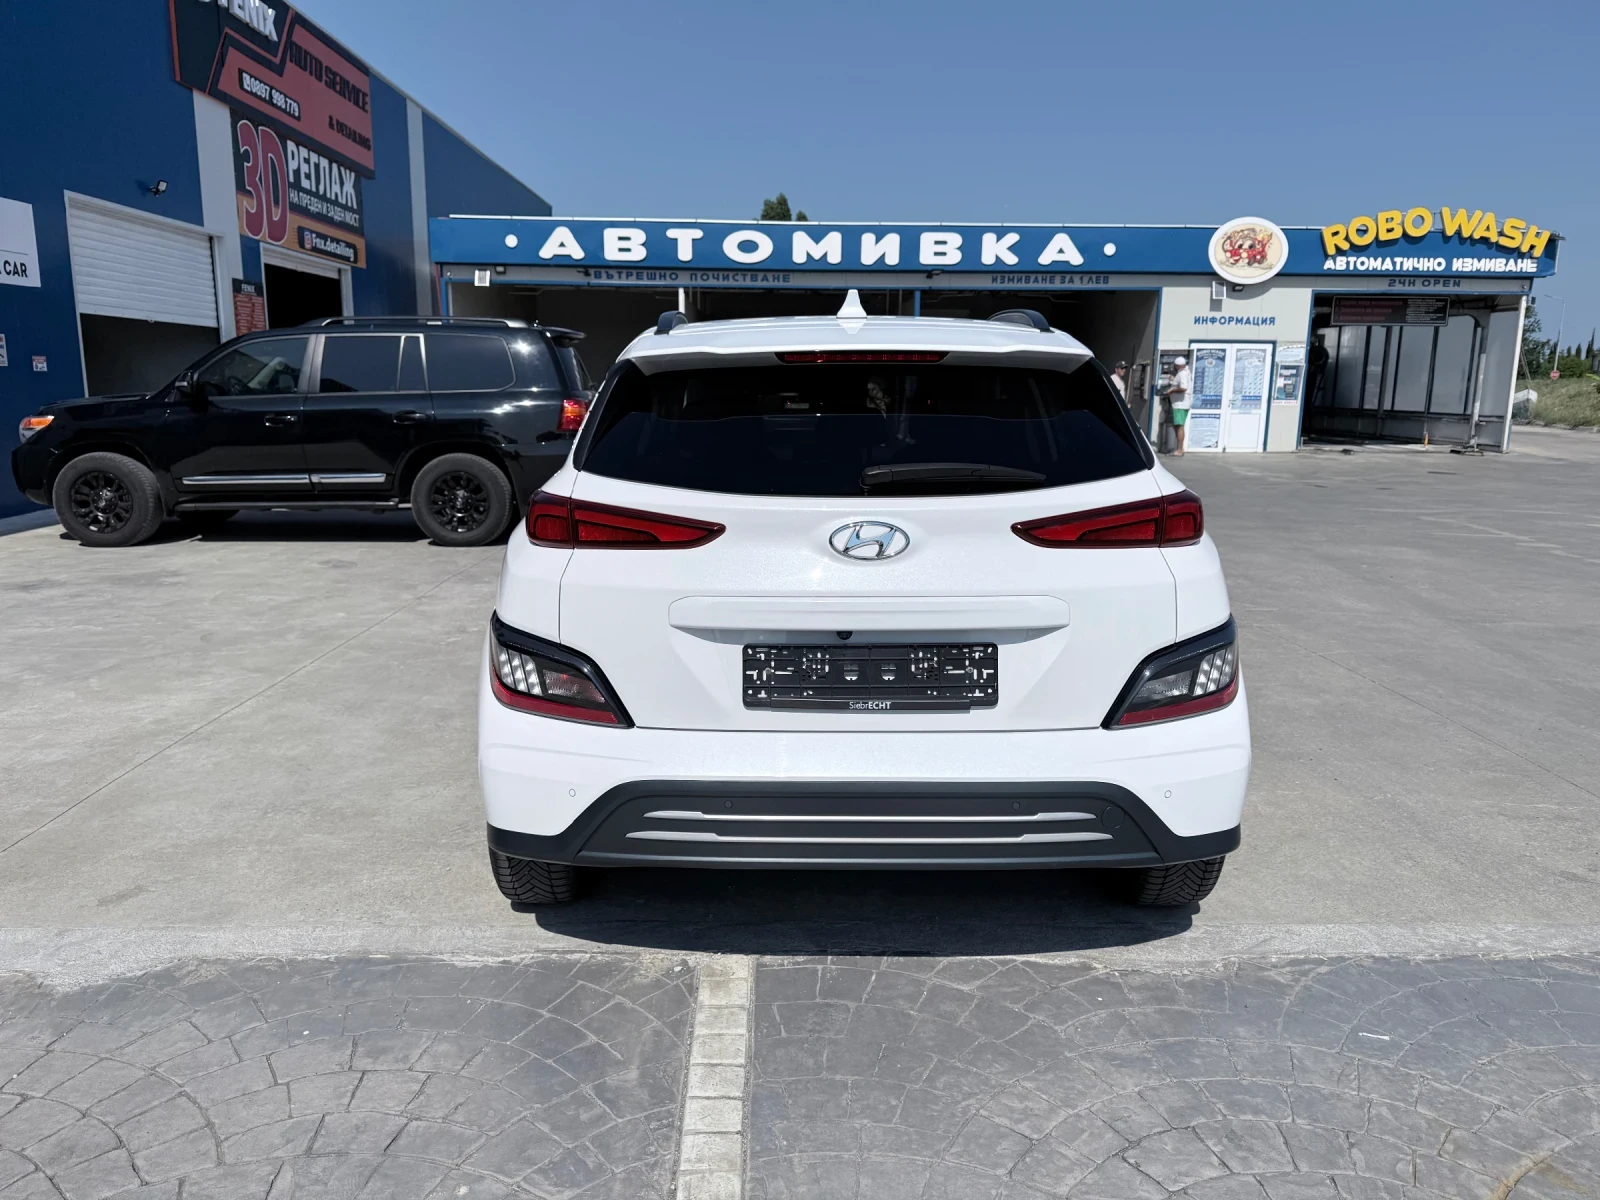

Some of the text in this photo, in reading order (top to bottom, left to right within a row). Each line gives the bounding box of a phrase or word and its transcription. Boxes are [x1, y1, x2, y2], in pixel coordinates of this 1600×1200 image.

[217, 0, 278, 42] ENIX
[290, 42, 369, 114] AUTO SERVICE
[237, 119, 289, 245] 3D
[286, 139, 358, 210] РЕГЛАЖ
[289, 187, 299, 205] НА
[1321, 206, 1551, 257] ROBO WASH
[538, 225, 1085, 267] АВТОМИВКА
[3, 259, 28, 278] CAR
[1323, 256, 1538, 273] АВТОМАТИЧНО ИЗМИВАНЕ
[593, 270, 791, 284] ВЪТРЕШНО ПОЧИСТВАНЕ
[991, 274, 1056, 285] ИЗМИВАНЕ
[1059, 275, 1075, 285] ЗА
[1087, 275, 1110, 285] ЛЕВ
[1421, 279, 1461, 288] OPEN
[1193, 315, 1276, 327] ИНФОРМАЦИЯ
[848, 701, 892, 710] SiebrECHT
